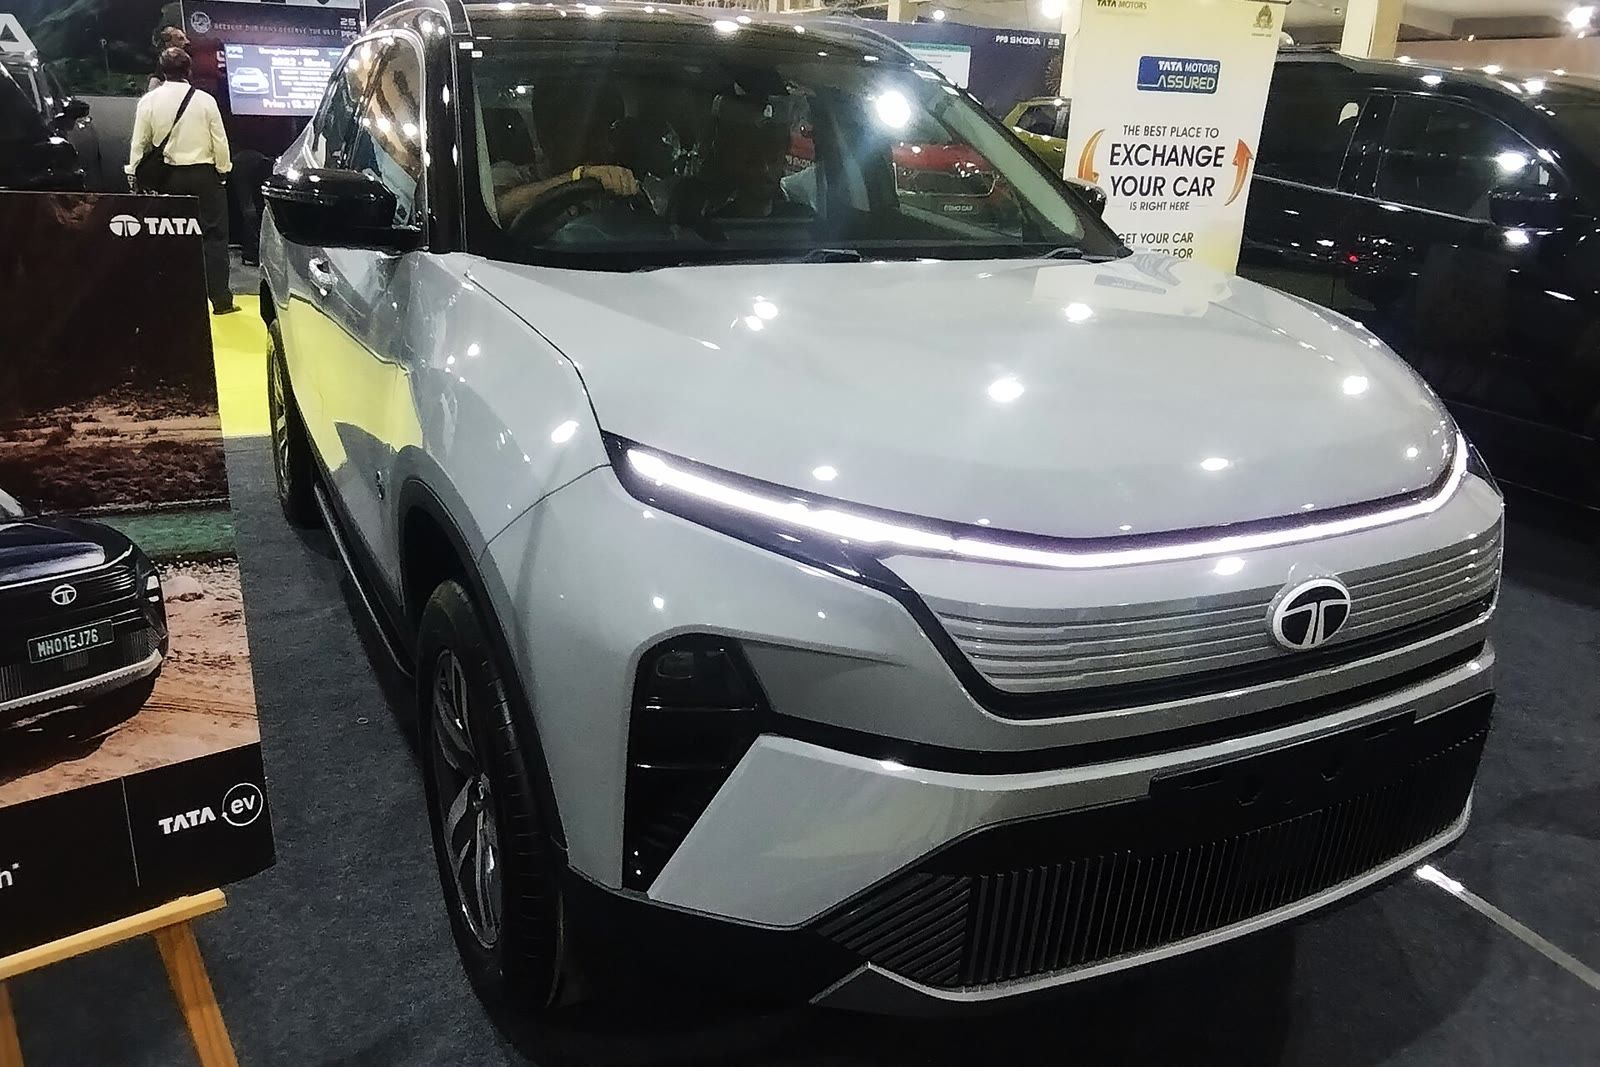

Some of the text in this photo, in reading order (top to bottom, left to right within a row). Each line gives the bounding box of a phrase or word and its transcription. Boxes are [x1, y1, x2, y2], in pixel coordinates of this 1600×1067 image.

[1118, 1, 1147, 9] MOTORS
[1009, 36, 1041, 45] SKODA
[1158, 60, 1219, 74] TATA MOTORS
[1158, 74, 1216, 90] ASSURED
[1123, 124, 1220, 139] THE BEST PLACE TO
[1109, 143, 1226, 168] EXCHANGE
[1110, 175, 1216, 197] YOUR CAR
[1129, 201, 1190, 211] IS RIGHT HERE
[143, 217, 203, 235] TATA
[1140, 232, 1170, 244] YOUR
[1172, 232, 1194, 243] CAR
[1172, 248, 1194, 259] FOR
[37, 628, 99, 658] MH01EJ76
[158, 794, 256, 835] TATA ev
